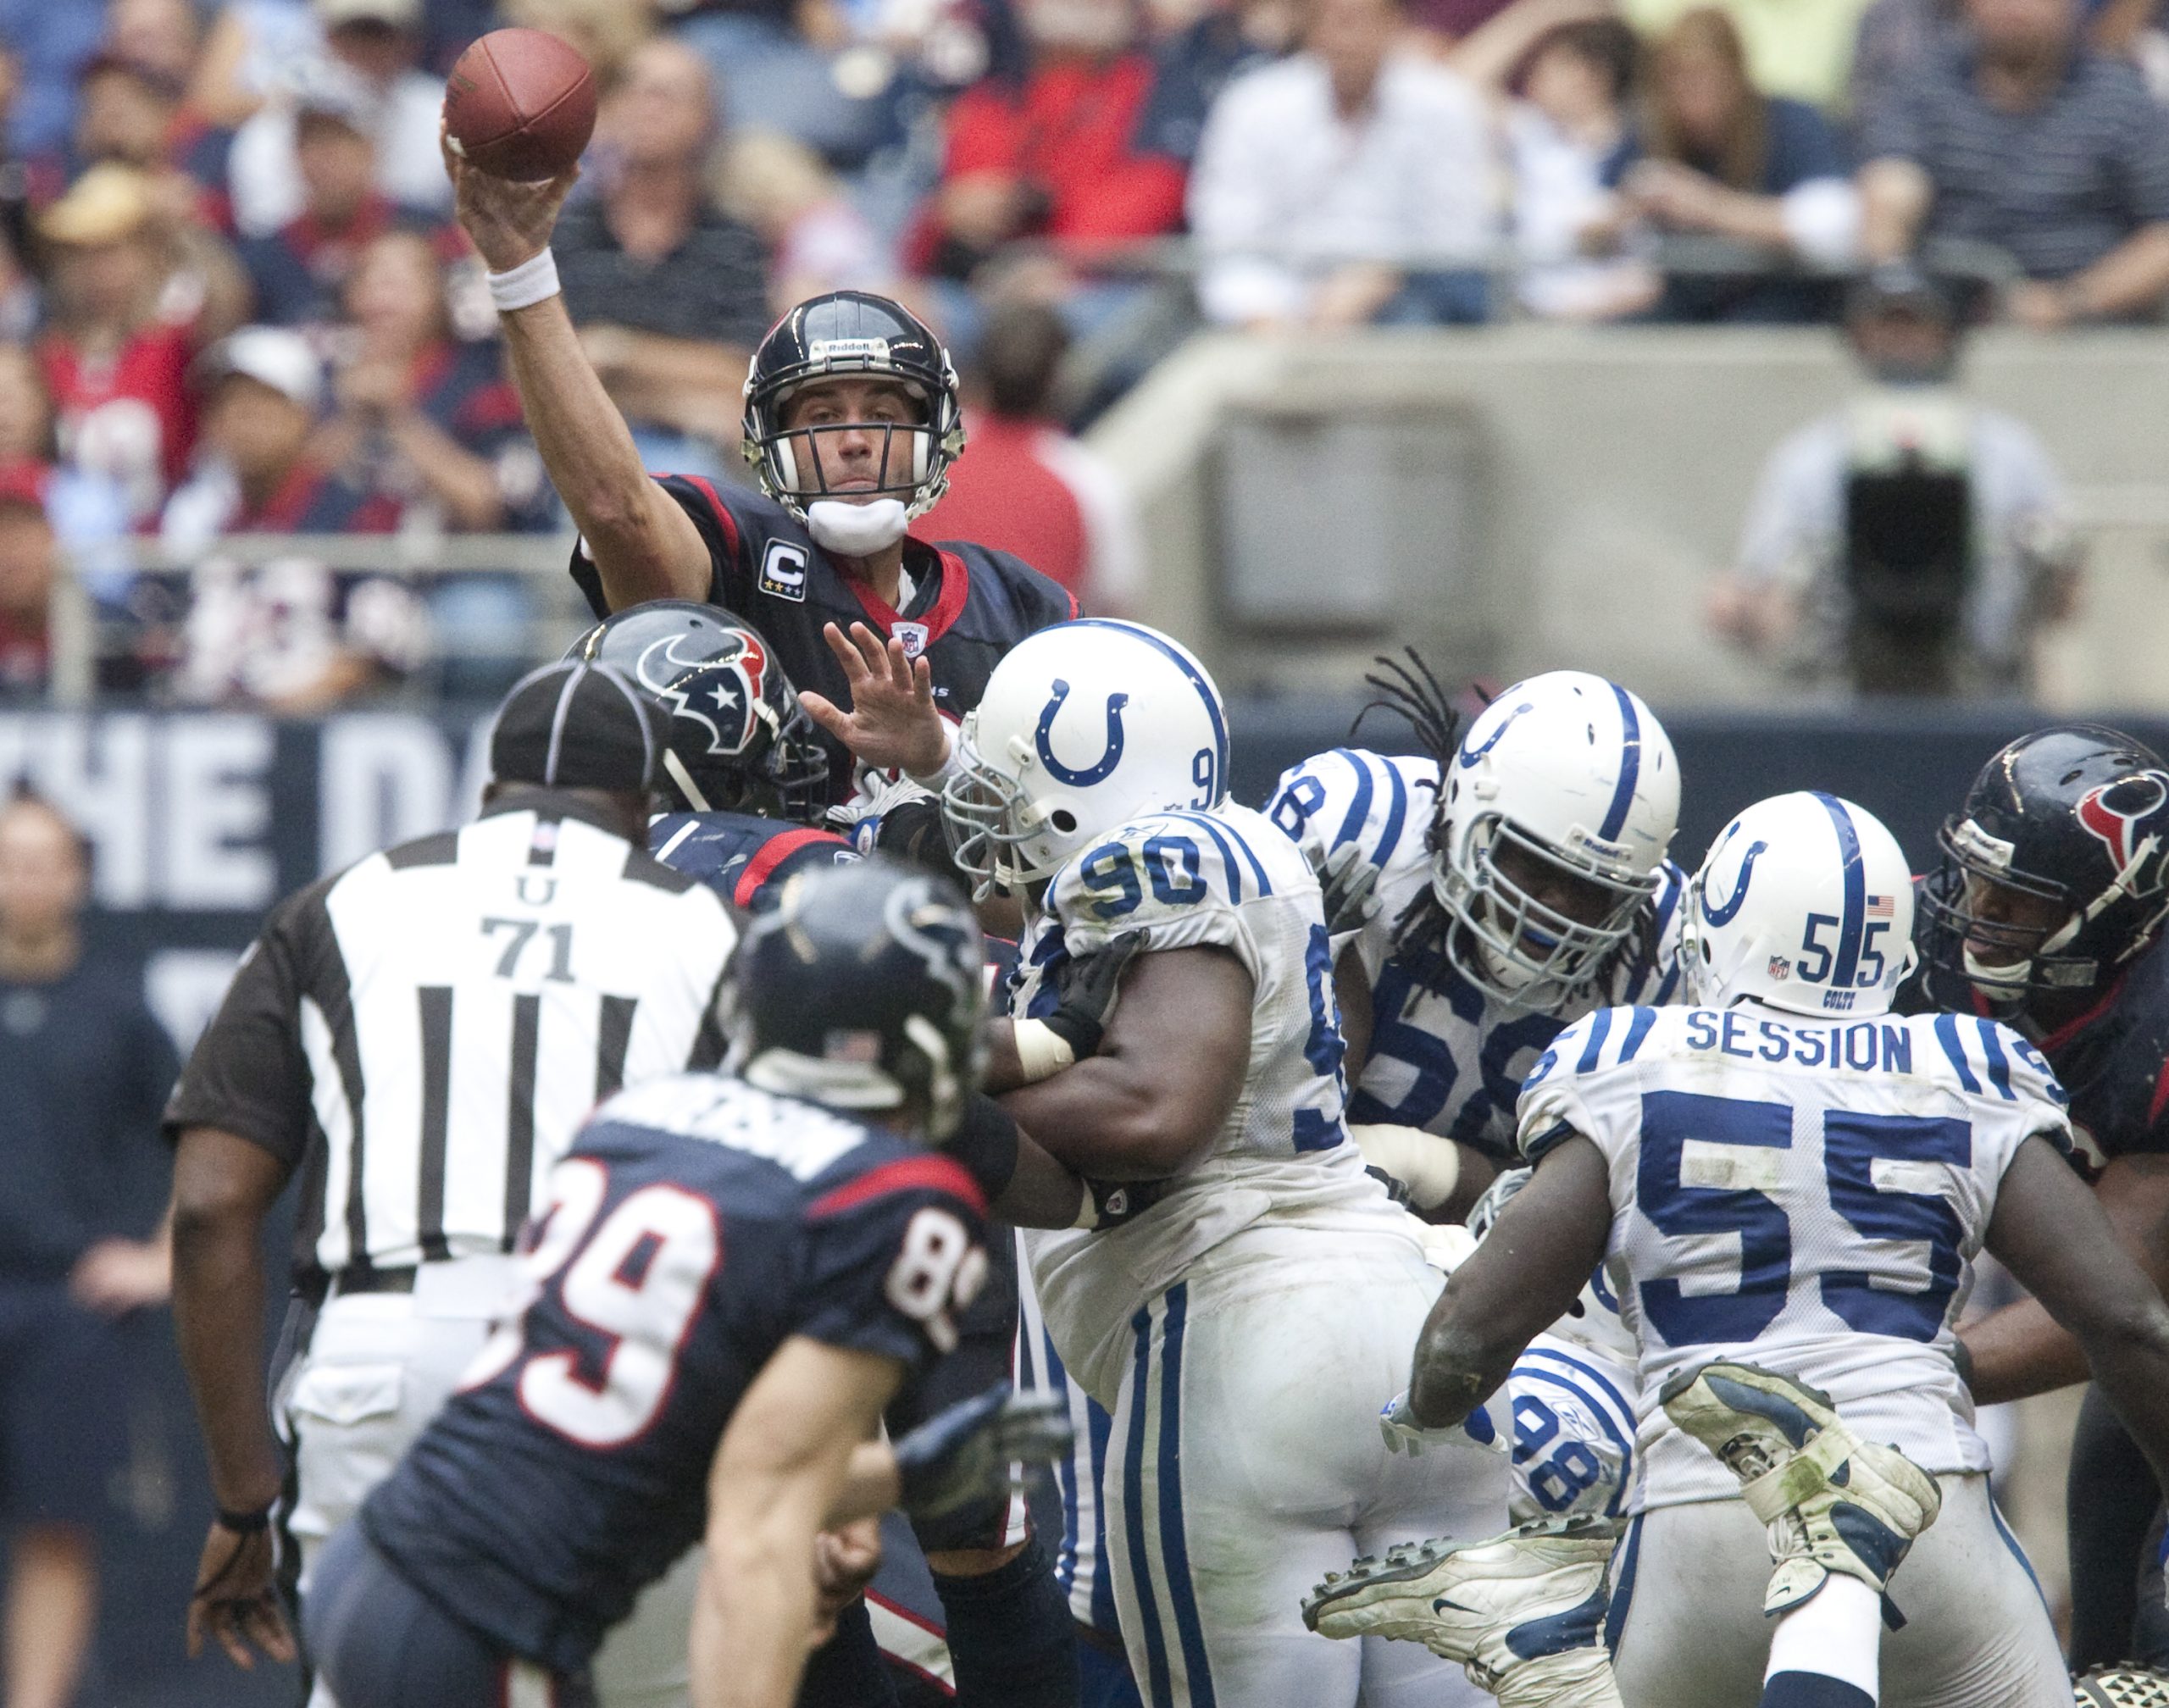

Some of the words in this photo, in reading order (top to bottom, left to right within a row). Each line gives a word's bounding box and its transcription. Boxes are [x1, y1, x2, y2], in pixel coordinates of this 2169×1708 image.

[829, 342, 870, 352] Riddell
[766, 545, 805, 586] C
[515, 874, 558, 906] U
[1080, 836, 1207, 919] 90
[480, 916, 577, 984] 71
[1797, 912, 1890, 987] 55
[1822, 989, 1856, 1010] COLTS
[1686, 1011, 1912, 1073] SESSION
[1637, 1090, 1972, 1344] 55
